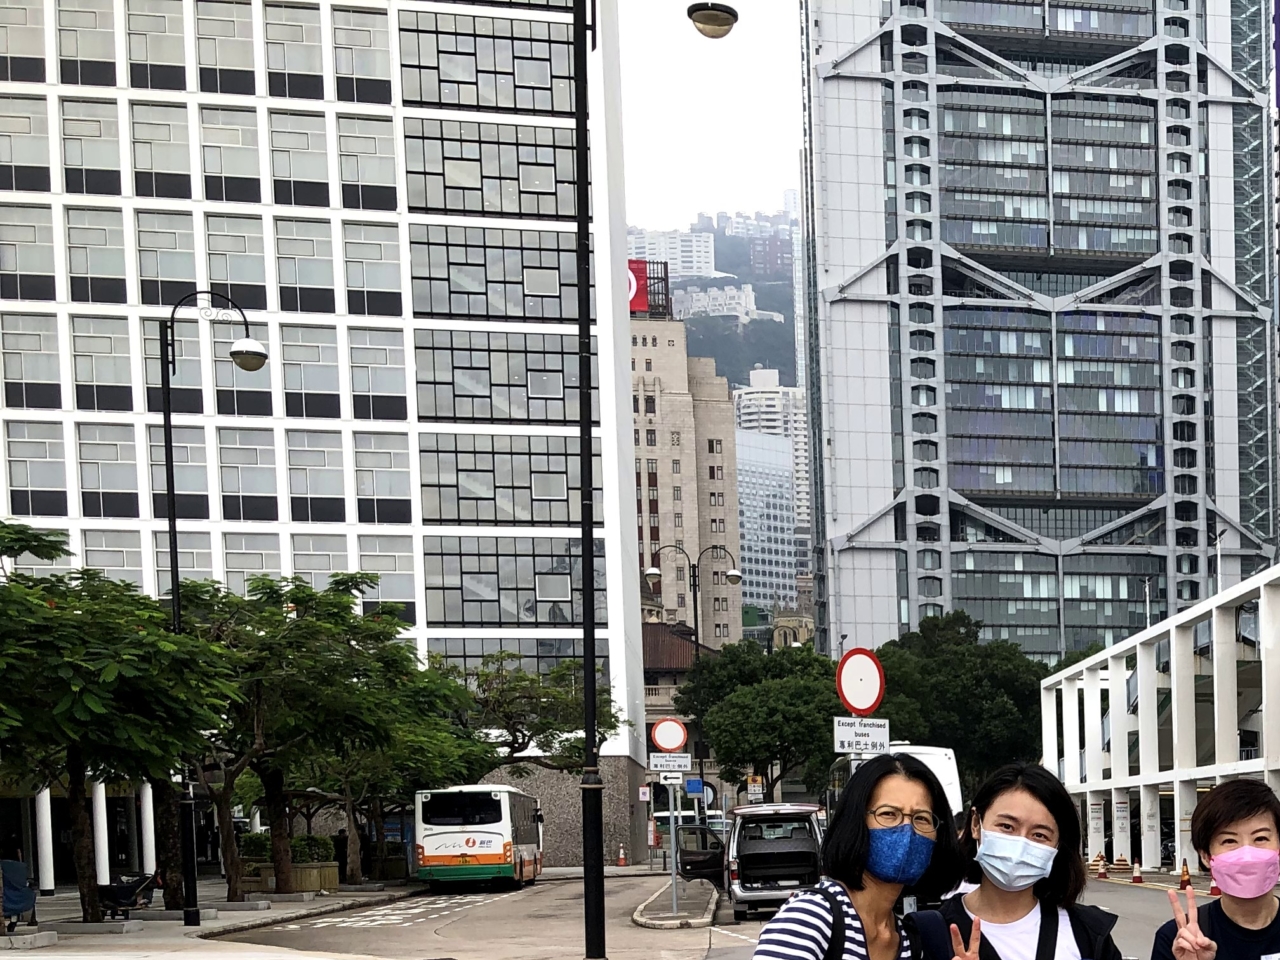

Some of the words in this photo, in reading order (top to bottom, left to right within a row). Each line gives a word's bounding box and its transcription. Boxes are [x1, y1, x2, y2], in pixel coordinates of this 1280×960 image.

[837, 719, 856, 728] Except
[858, 720, 886, 729] franchised
[854, 730, 870, 738] buses
